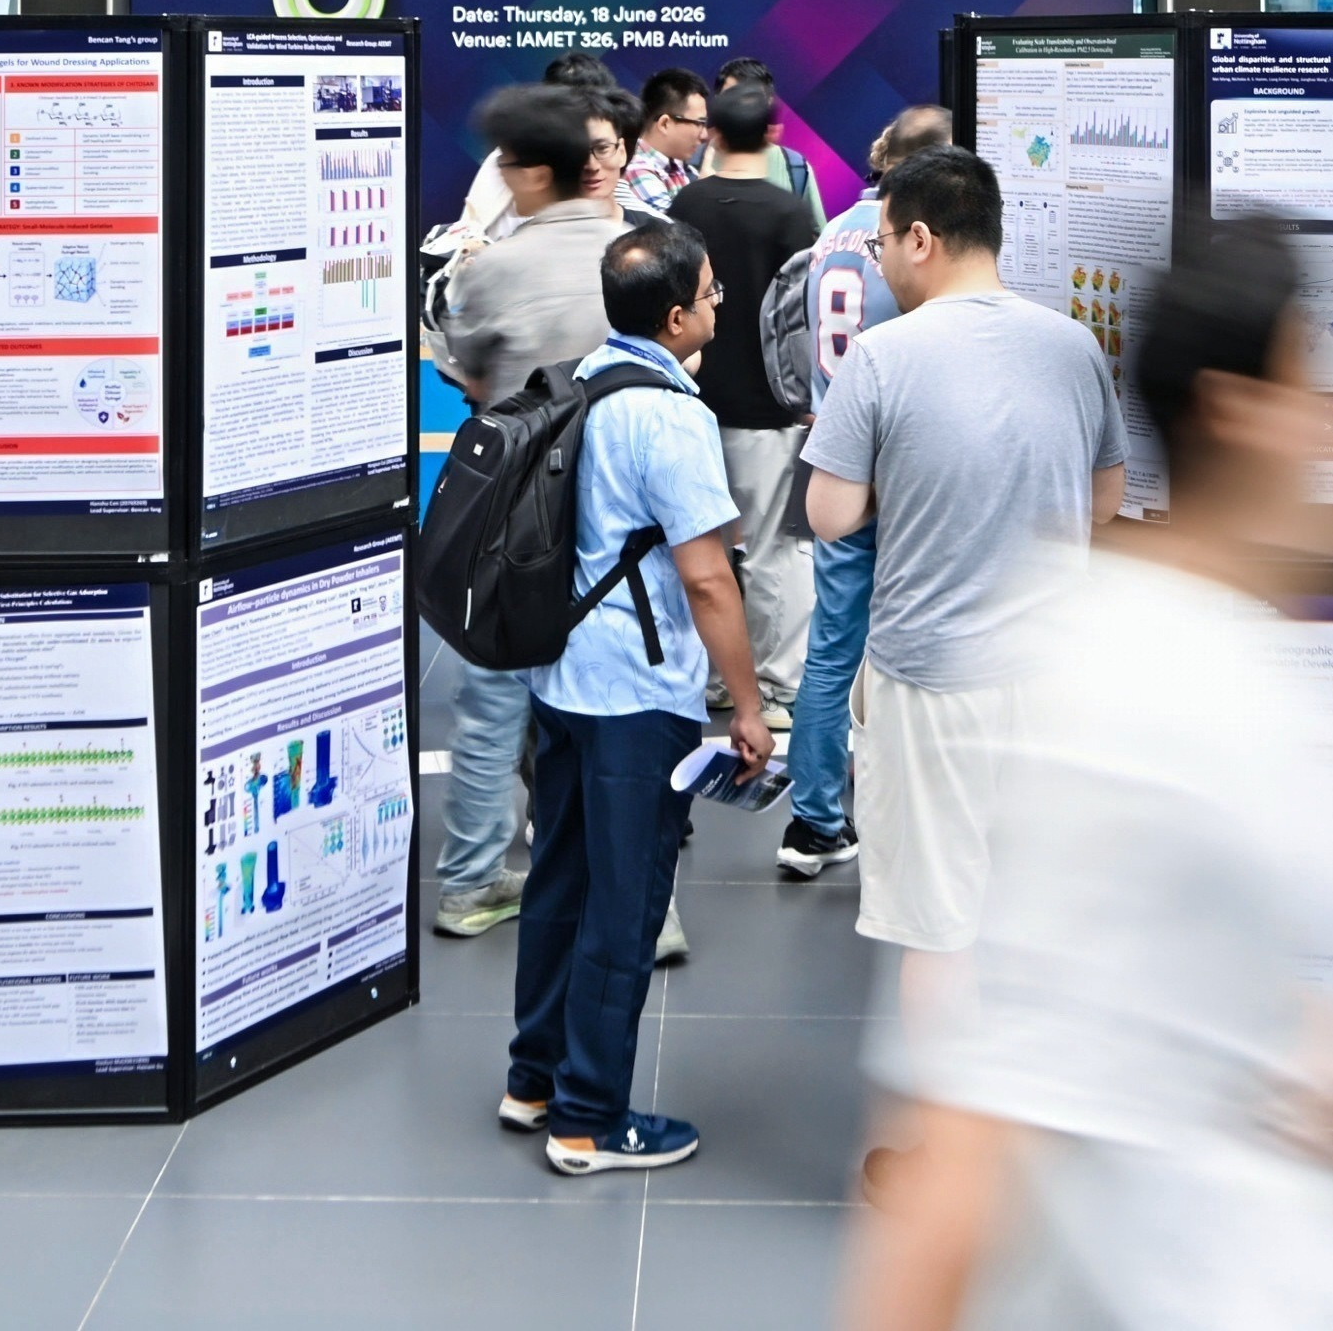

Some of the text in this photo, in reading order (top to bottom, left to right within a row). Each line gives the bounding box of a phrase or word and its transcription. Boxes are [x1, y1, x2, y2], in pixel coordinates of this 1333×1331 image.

[453, 6, 705, 27] Date: Thursday, 18 June 2026
[138, 37, 158, 45] group
[453, 31, 728, 50] Venue: IAMET 326, PMB Atrium
[1234, 38, 1266, 46] Nottingham
[63, 58, 97, 67] Dressing
[100, 58, 149, 67] Applications
[1212, 56, 1235, 64] Global
[1239, 56, 1275, 65] disparities
[1279, 56, 1292, 64] and
[1296, 56, 1330, 64] structural
[1212, 66, 1328, 74] urban climate resilience research
[281, 587, 310, 602] dynamics
[320, 579, 330, 589] Dry
[332, 572, 354, 585] Powder
[356, 565, 379, 578] Inhalers
